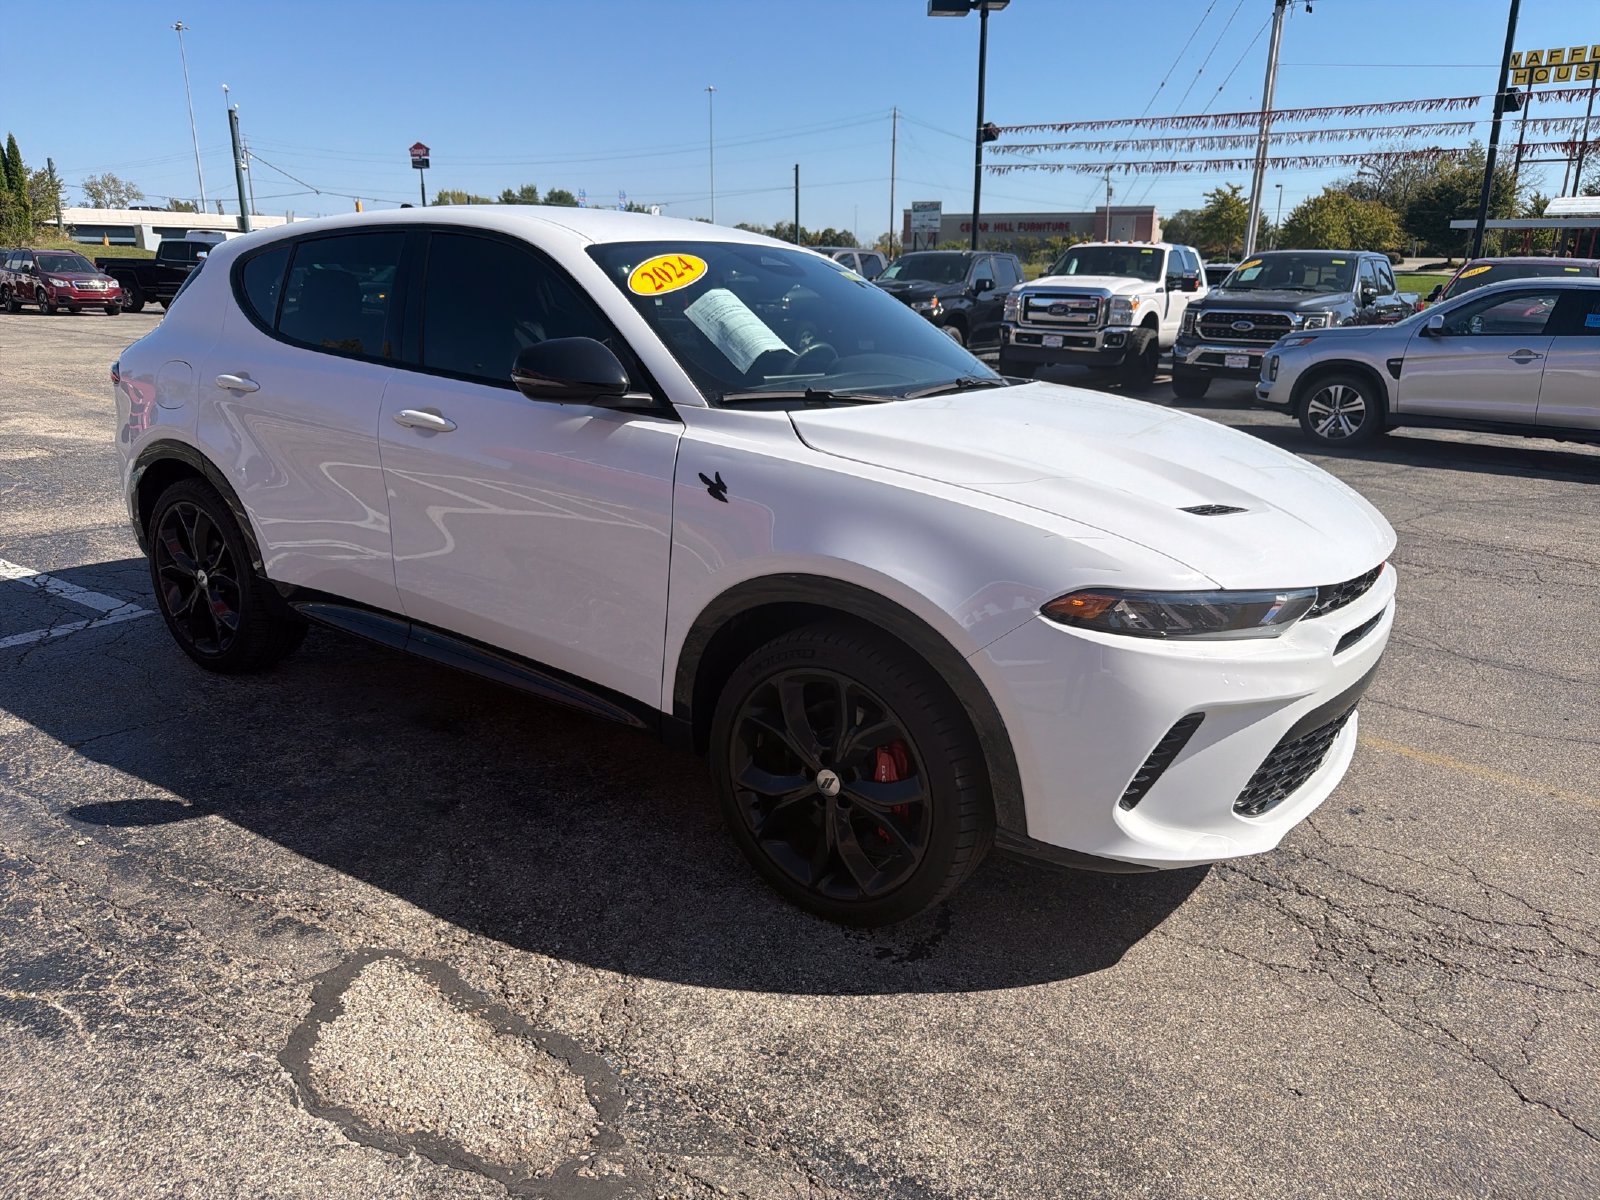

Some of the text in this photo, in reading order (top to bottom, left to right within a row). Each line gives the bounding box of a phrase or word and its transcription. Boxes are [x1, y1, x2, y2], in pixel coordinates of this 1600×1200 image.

[993, 222, 1014, 233] HILL
[1017, 221, 1070, 233] FURNITURE
[641, 256, 695, 291] 2024
